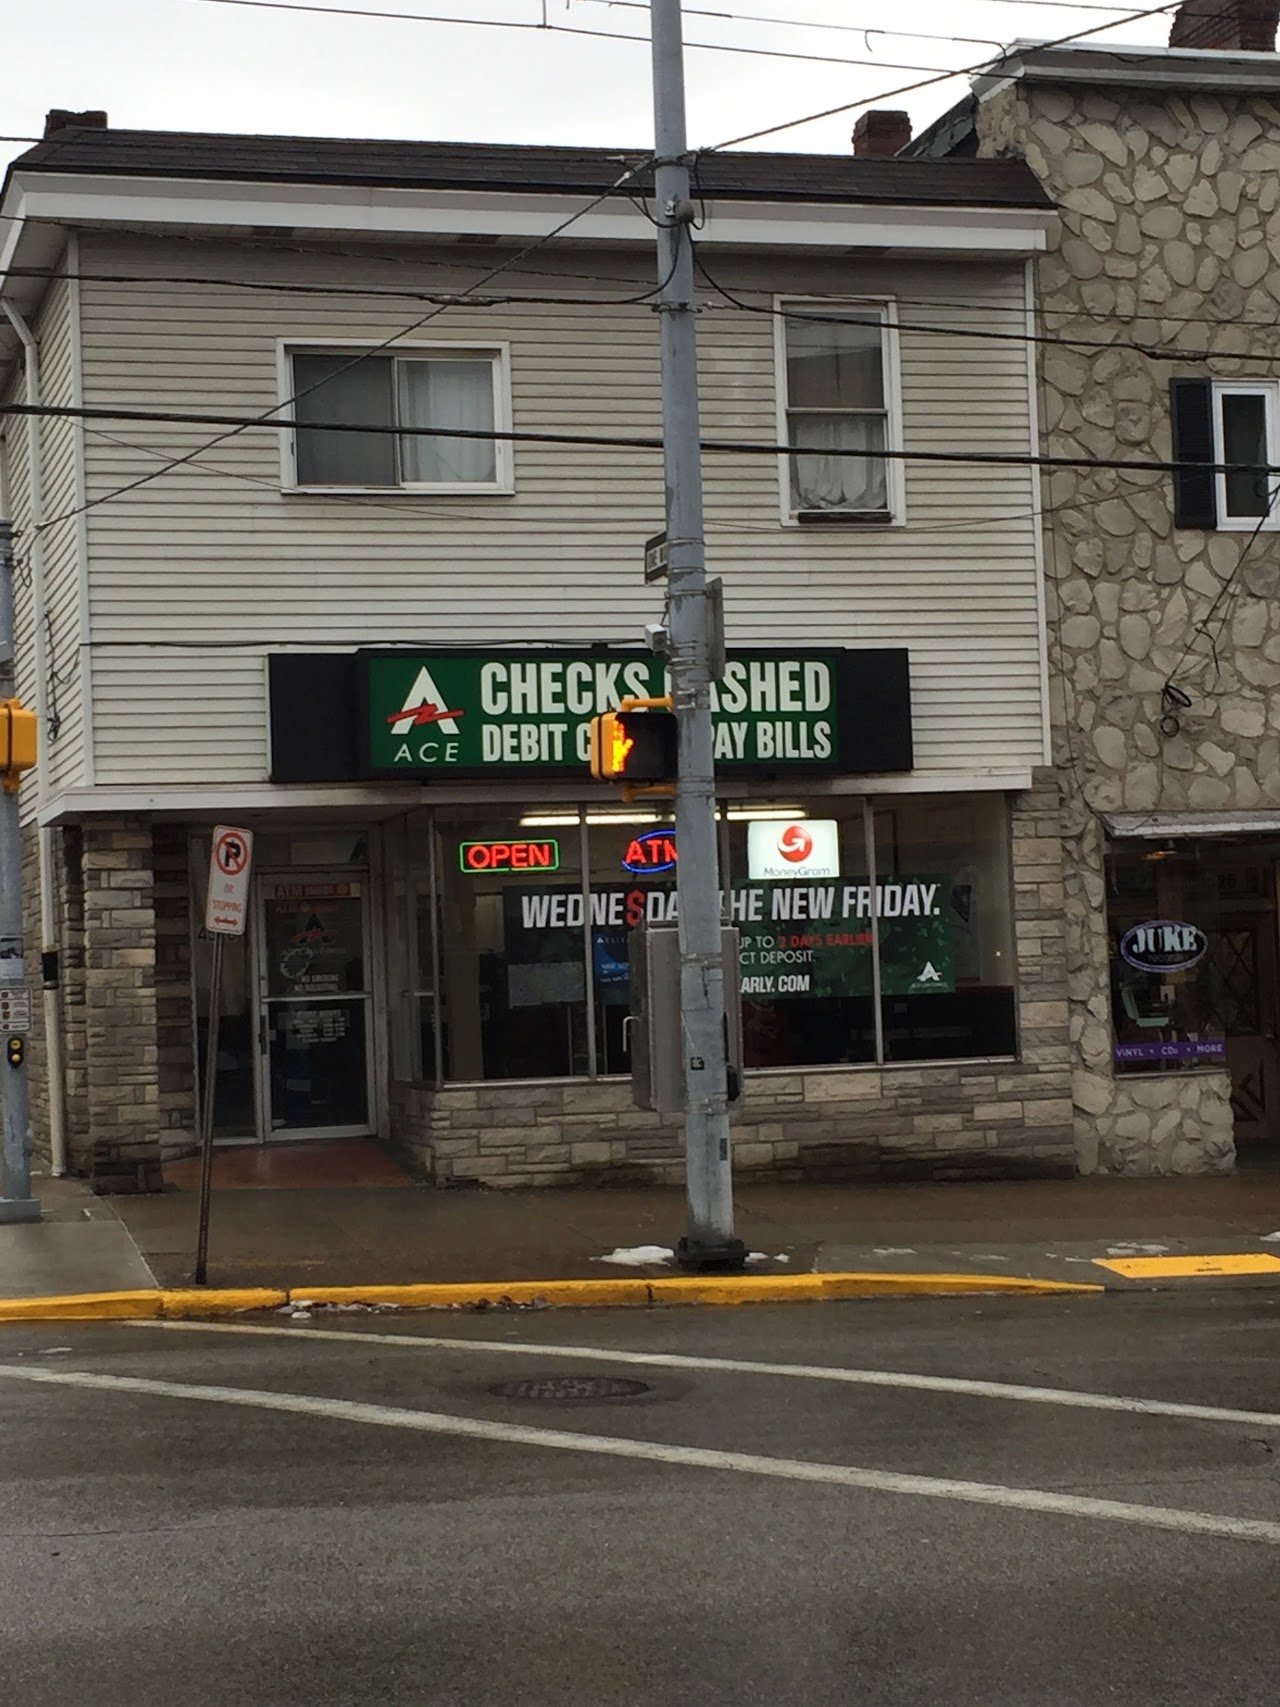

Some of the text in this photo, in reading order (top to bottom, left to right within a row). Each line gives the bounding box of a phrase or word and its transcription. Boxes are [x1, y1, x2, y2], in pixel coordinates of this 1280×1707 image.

[480, 661, 650, 716] CHECKS
[394, 742, 460, 763] ACE
[482, 723, 567, 763] DEBIT
[756, 720, 832, 760] BILLS
[467, 843, 551, 868] OPEN
[763, 867, 831, 878] MoneyGram
[522, 888, 679, 929] WEDNESDA
[771, 887, 833, 921] NEW
[756, 935, 775, 948] TO
[778, 935, 787, 948] 2
[791, 934, 823, 948] DAYS
[1131, 925, 1198, 954] JUKE
[1115, 1046, 1144, 1058] VINYL
[1196, 1043, 1223, 1054] MORE
